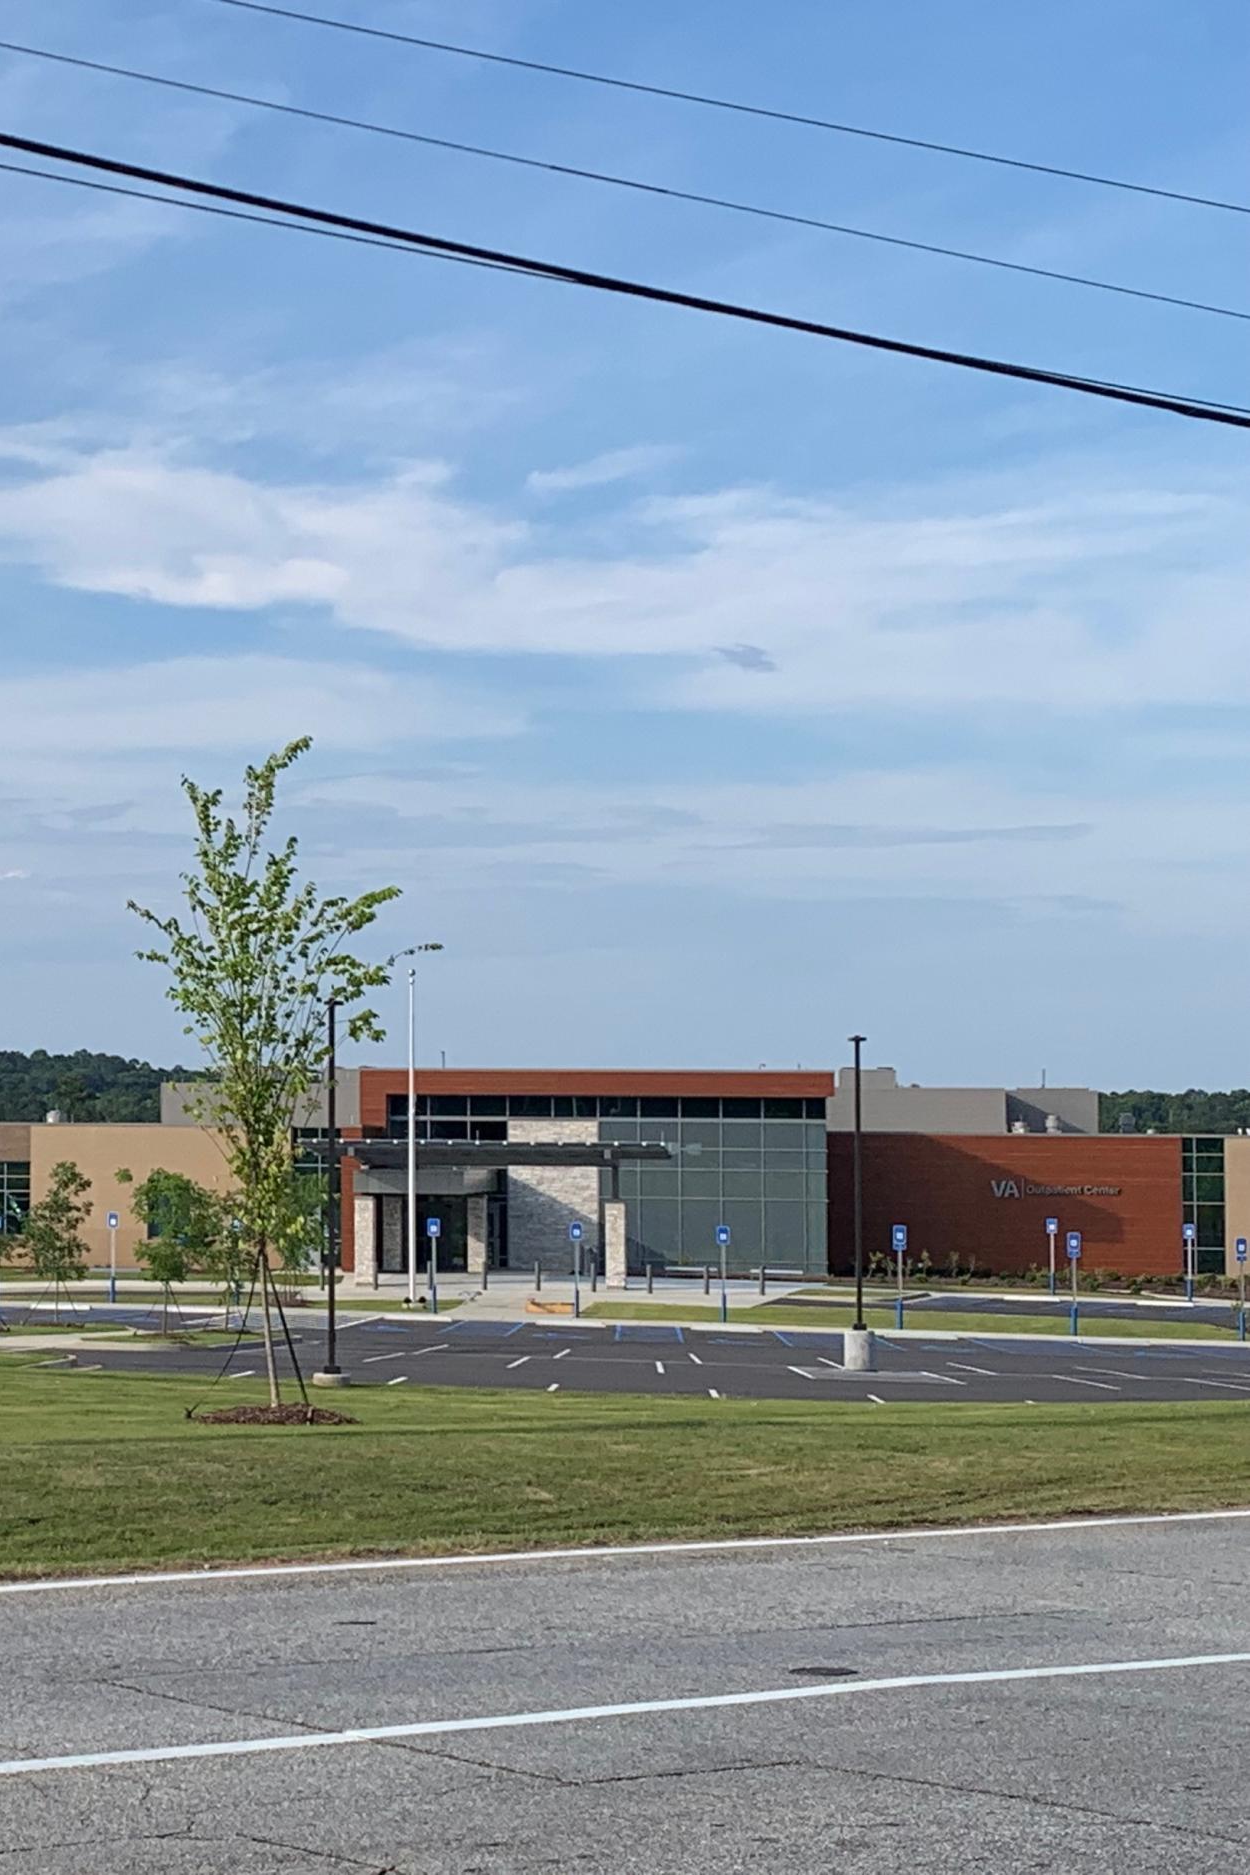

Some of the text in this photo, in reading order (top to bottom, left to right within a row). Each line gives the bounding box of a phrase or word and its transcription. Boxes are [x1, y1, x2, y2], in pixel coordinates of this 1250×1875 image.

[990, 1180, 1020, 1198] VA
[1026, 1184, 1121, 1197] Outpatient Center
